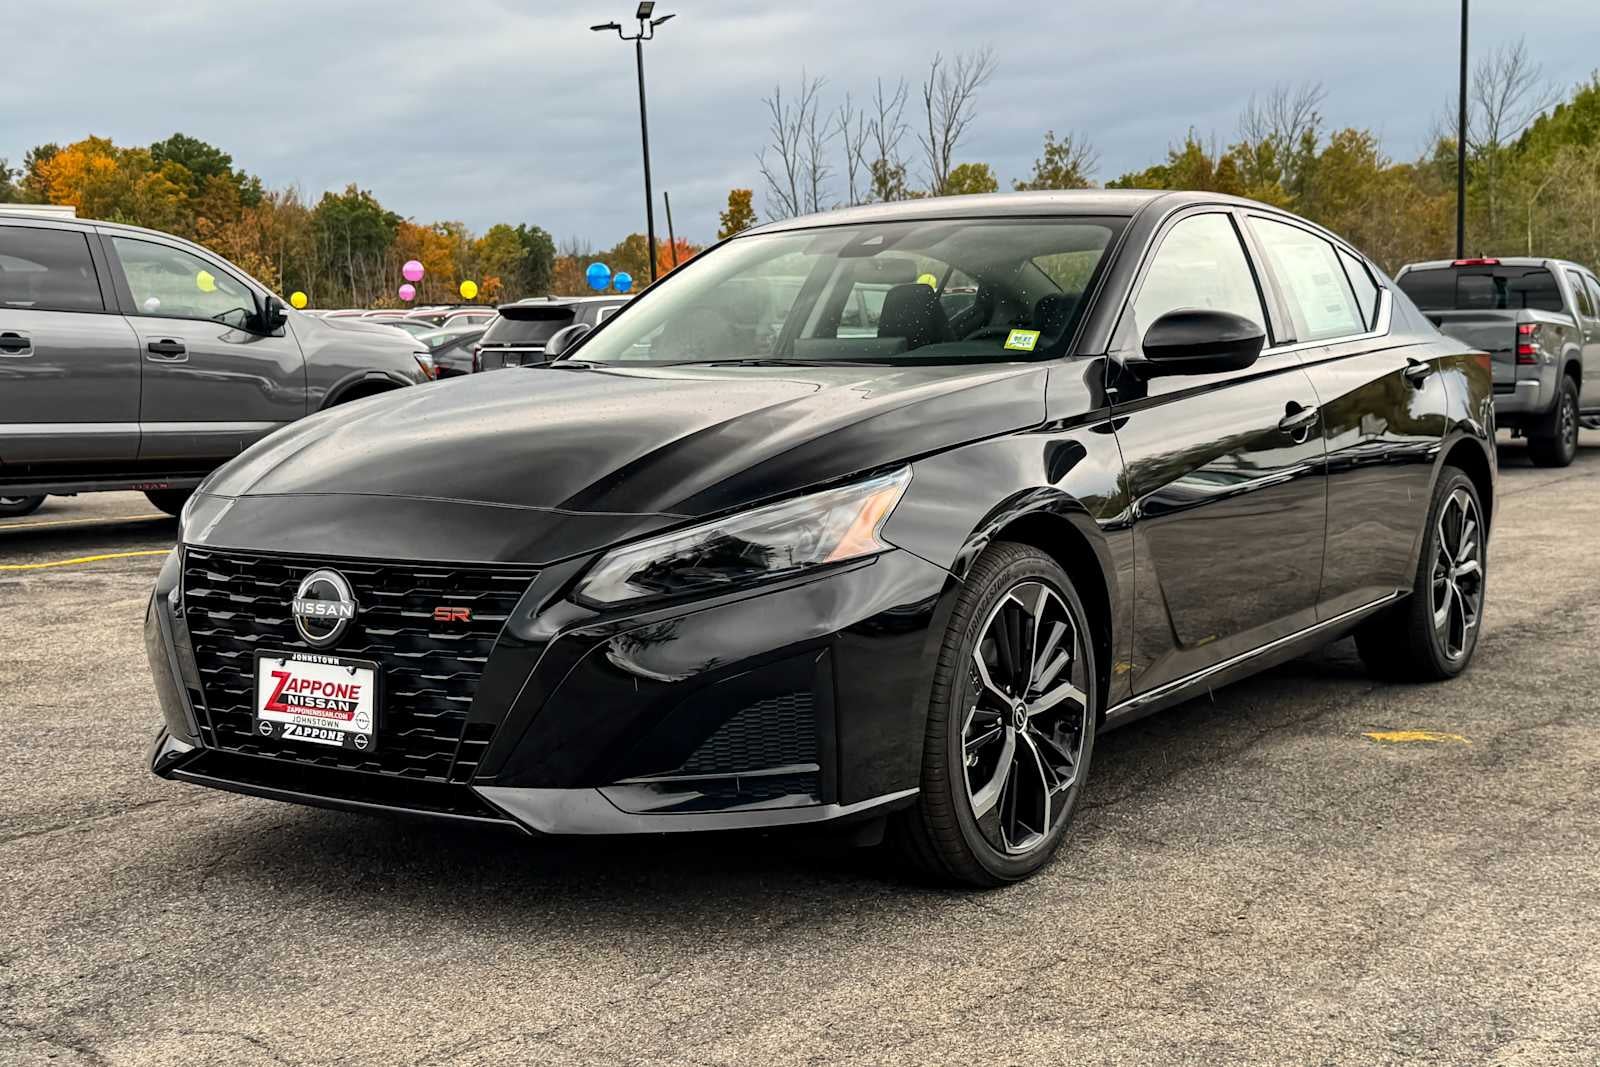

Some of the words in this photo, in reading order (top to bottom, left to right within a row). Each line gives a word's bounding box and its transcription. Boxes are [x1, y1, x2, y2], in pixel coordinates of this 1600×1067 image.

[293, 601, 353, 616] NISSAN
[434, 607, 472, 622] SR
[292, 653, 340, 665] JOHNSTOWN
[264, 670, 362, 710] ZAPPONE
[287, 695, 350, 711] NISSAN
[292, 716, 340, 728] JOHNSTOWN
[281, 723, 346, 746] ZAPPONE
